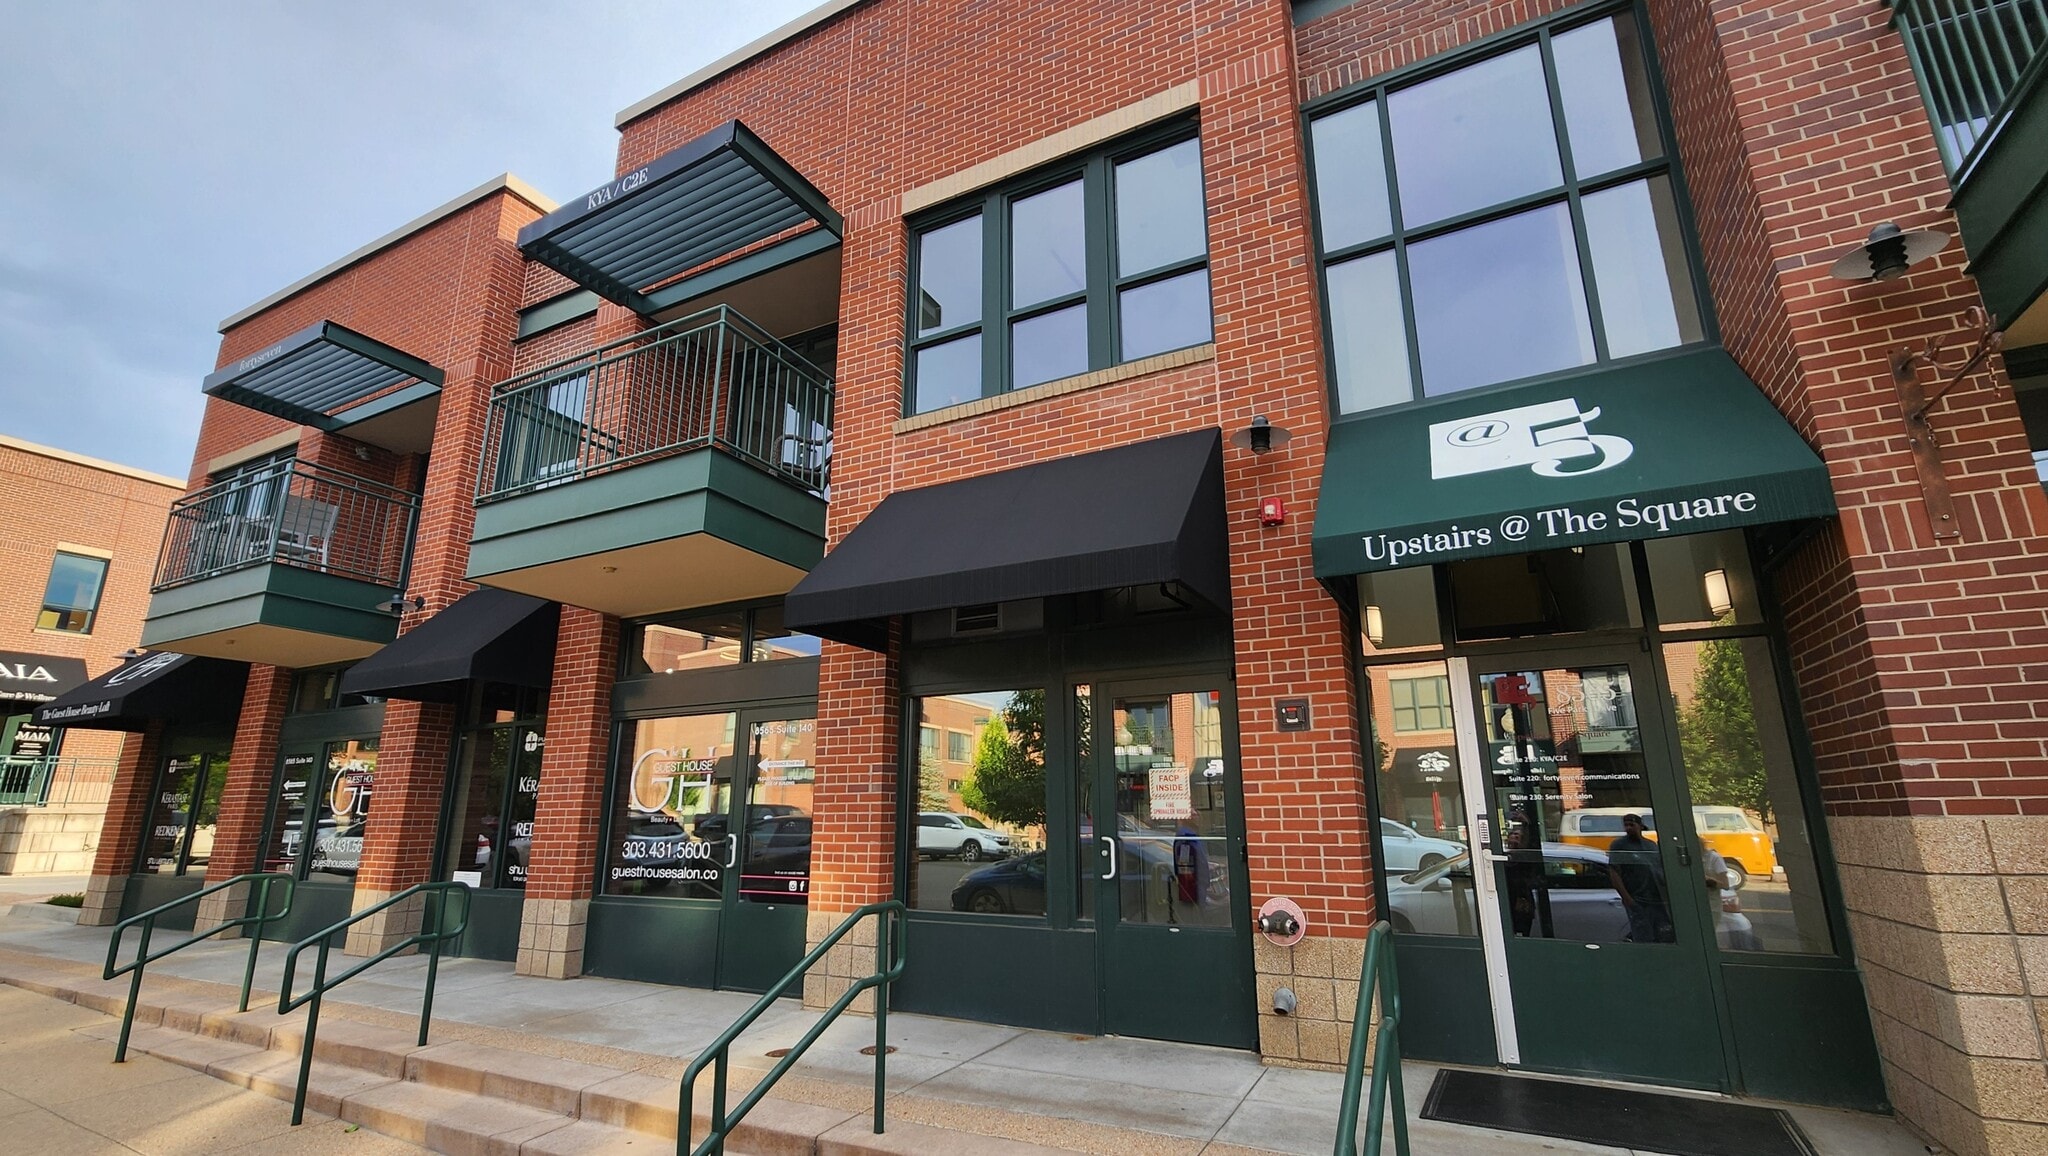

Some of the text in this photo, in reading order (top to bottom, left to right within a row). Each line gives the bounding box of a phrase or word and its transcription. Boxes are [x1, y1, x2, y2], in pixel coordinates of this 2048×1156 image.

[587, 167, 648, 210] KYA / C2E
[1362, 492, 1758, 565] Upstairs @ The Square
[776, 724, 797, 735] Suite
[654, 759, 714, 774] GUEST HOUSE
[518, 776, 541, 792] KÉR
[1158, 774, 1180, 783] FACP
[1543, 774, 1580, 782] fortyseven
[1581, 773, 1640, 781] communications
[1155, 784, 1184, 792] INSIDE
[1545, 793, 1574, 802] Serenity
[1574, 792, 1594, 800] Salon
[622, 841, 711, 859] 303.431.5600
[508, 864, 524, 875] shu
[611, 865, 718, 880] guesthousesalon.co
